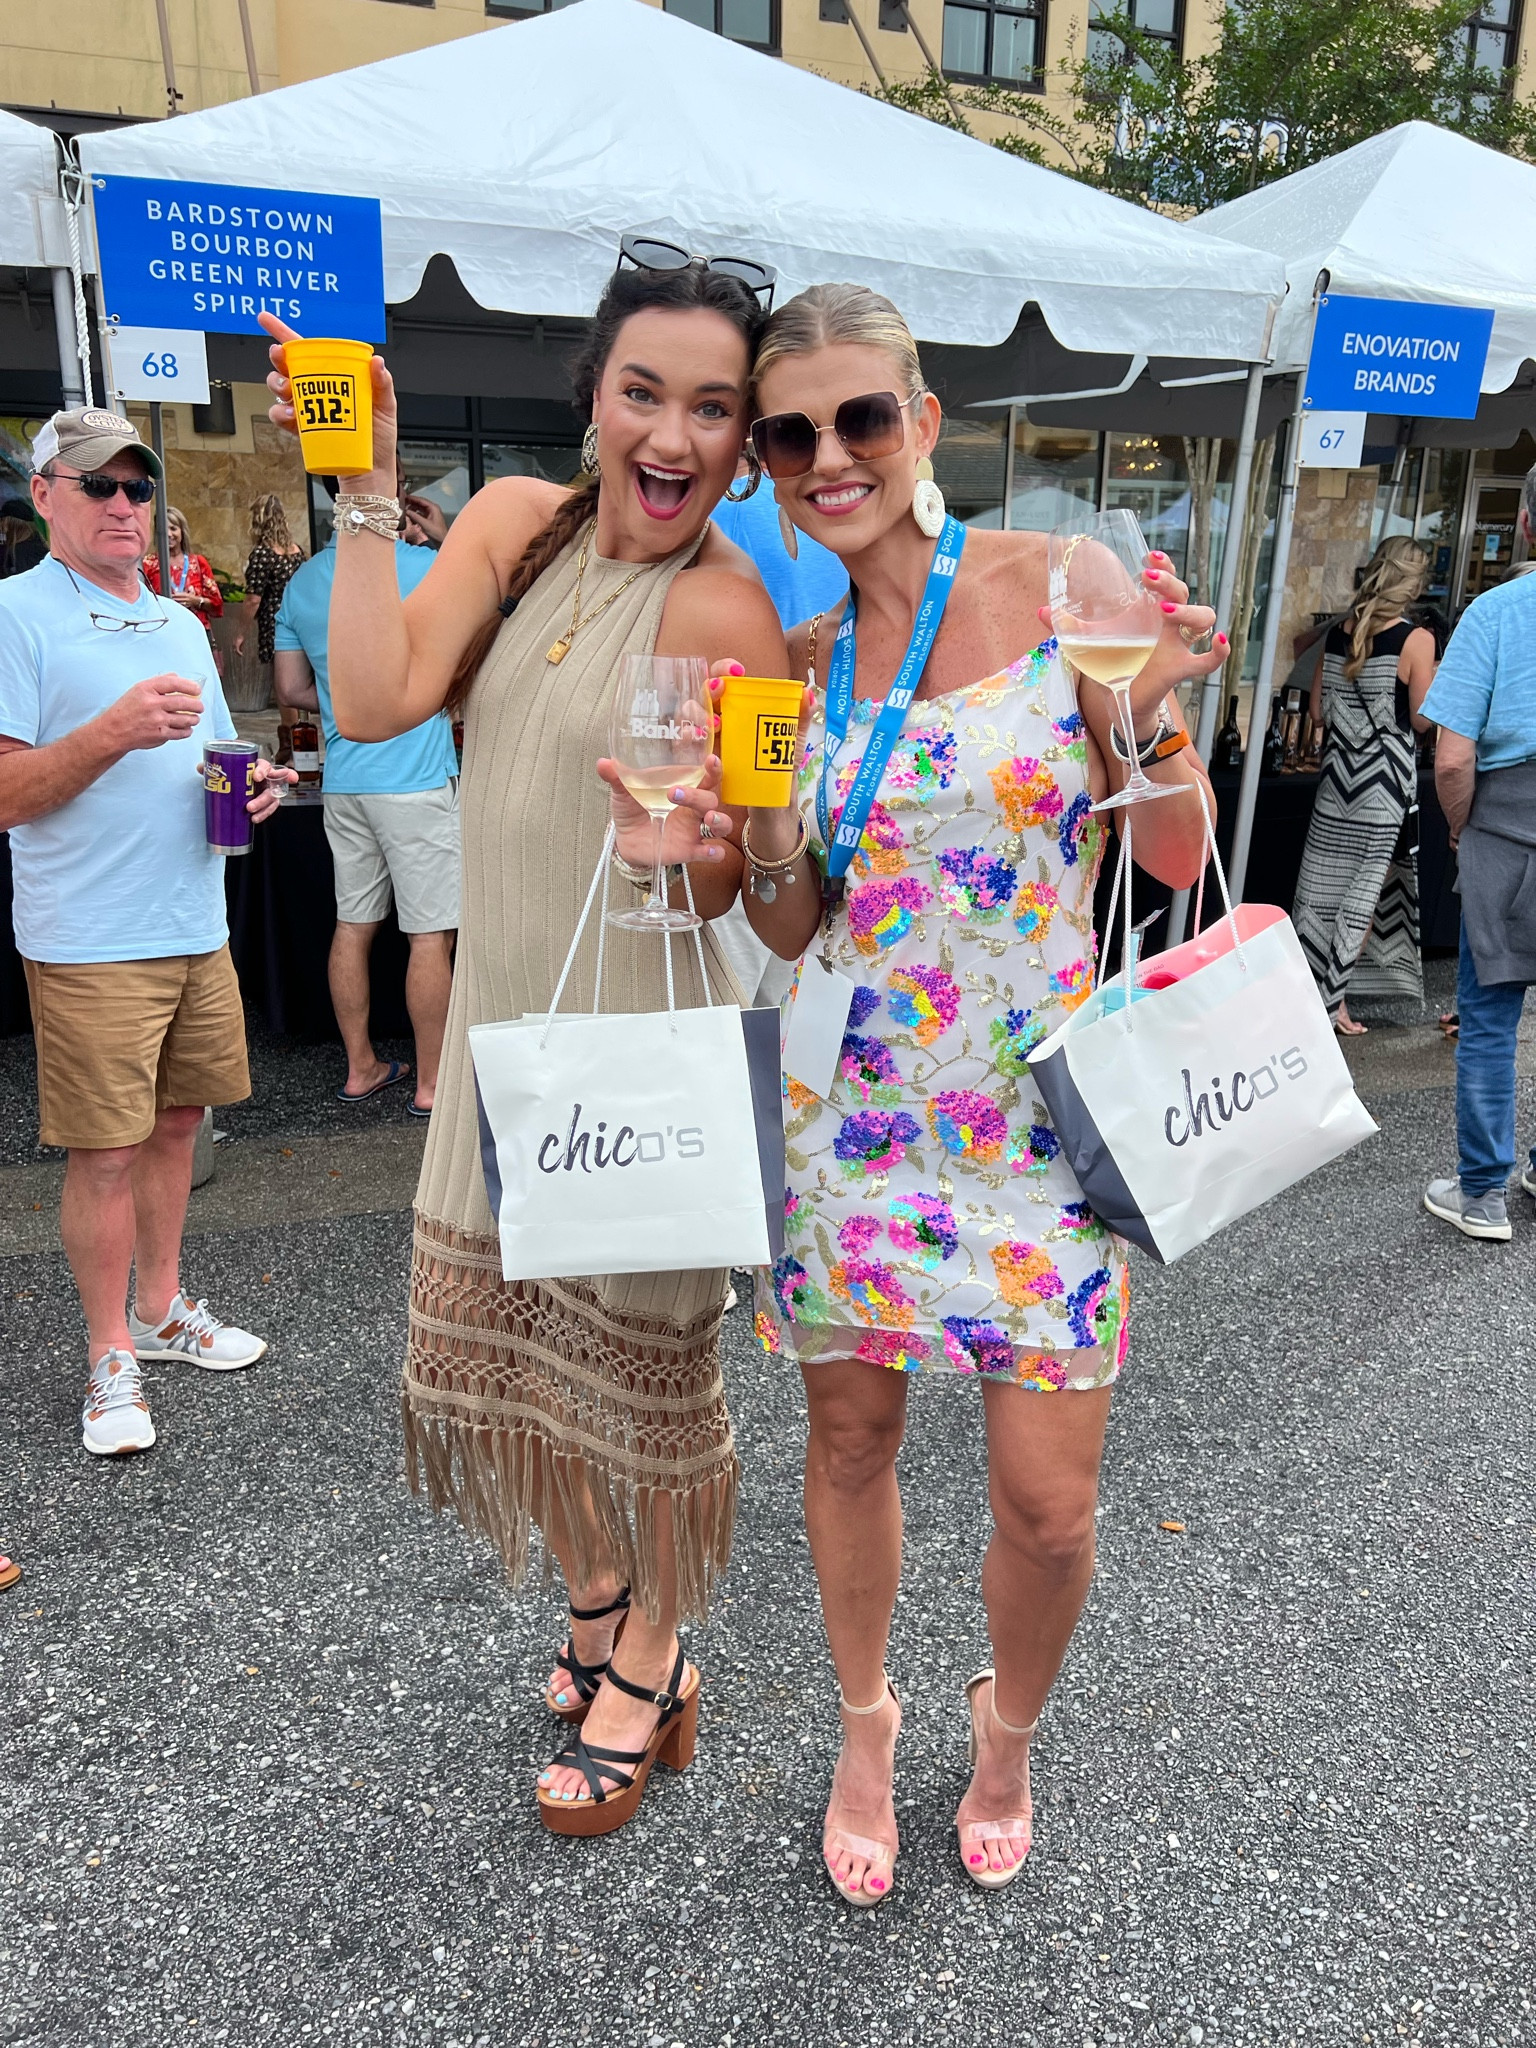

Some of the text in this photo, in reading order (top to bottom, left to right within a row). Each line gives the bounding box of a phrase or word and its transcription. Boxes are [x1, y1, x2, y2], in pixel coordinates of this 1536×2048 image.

[147, 199, 333, 235] BARDSTOWN
[171, 230, 314, 262] BOURBON
[149, 259, 339, 292] GREEN RIVER
[193, 292, 302, 318] SPIRITS
[1342, 332, 1460, 362] ENOVATION
[142, 352, 179, 379] 68
[1354, 369, 1437, 395] BRANDS
[296, 381, 349, 398] TEQUILA
[1319, 429, 1345, 449] 67
[941, 520, 957, 553] SOUTH
[898, 600, 935, 686] SOUTH WALTON
[918, 628, 934, 661] FLORIDA
[837, 638, 852, 715] SOUTH WALTON
[845, 731, 886, 822] SOUTH WALTON
[866, 762, 883, 797] FLORIDA
